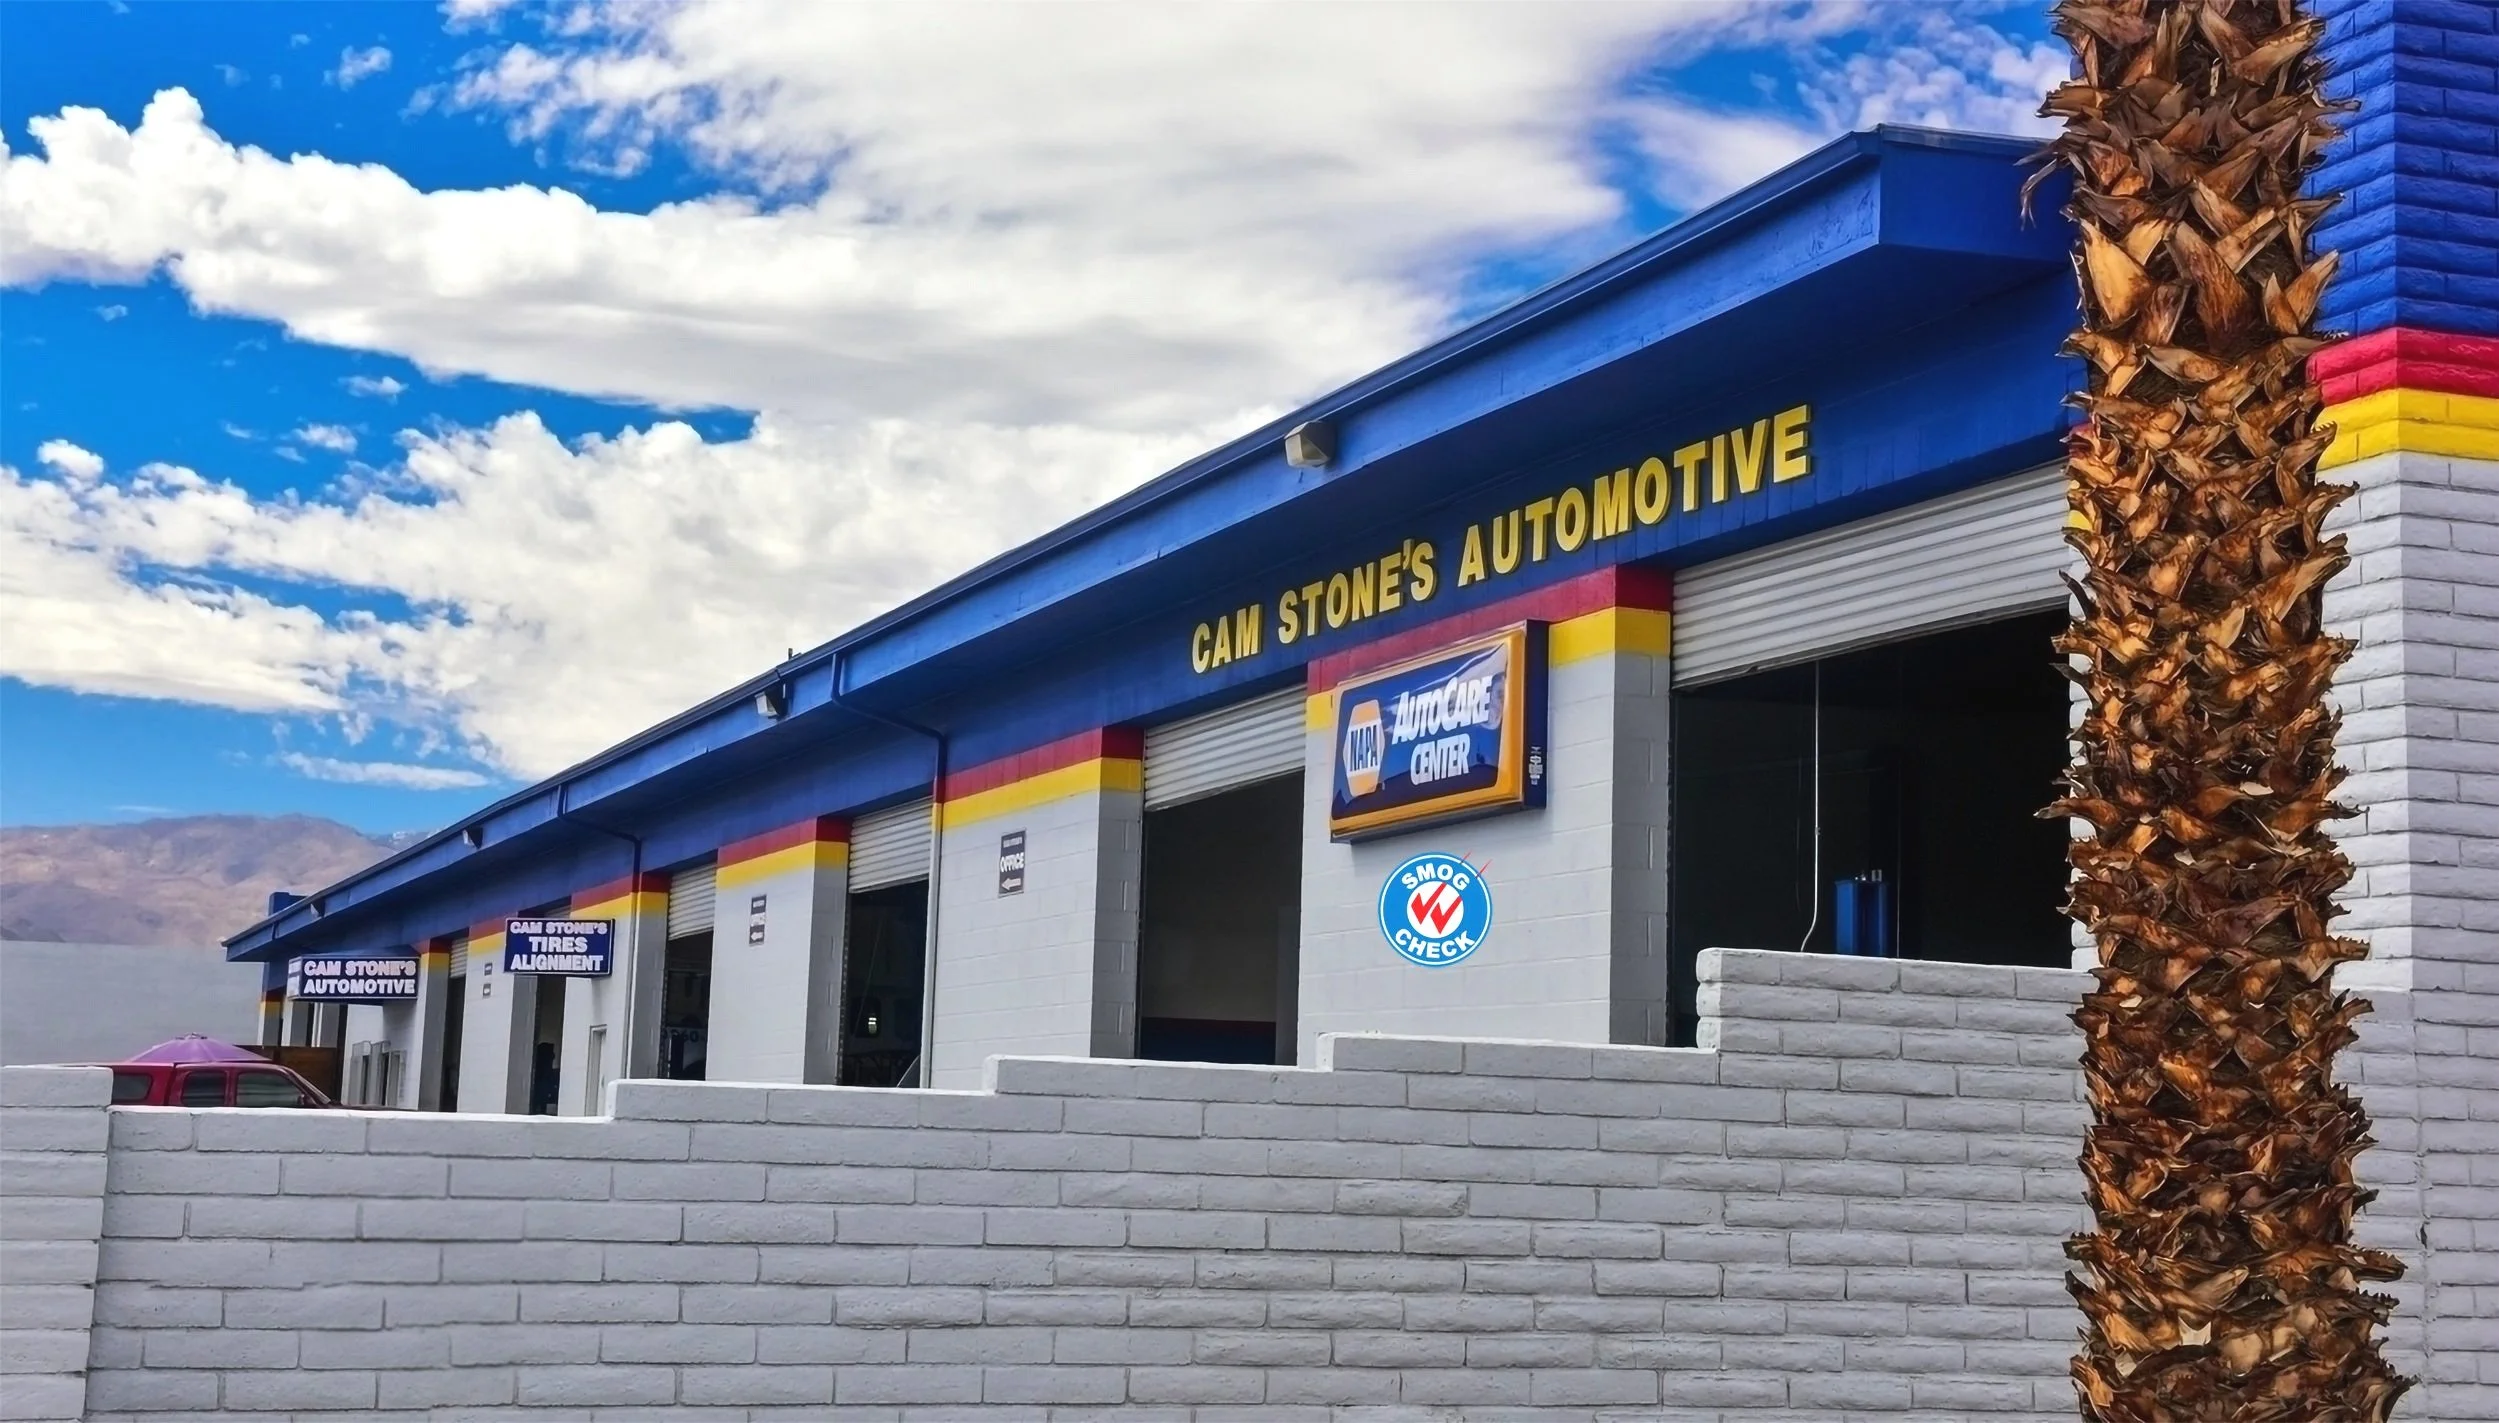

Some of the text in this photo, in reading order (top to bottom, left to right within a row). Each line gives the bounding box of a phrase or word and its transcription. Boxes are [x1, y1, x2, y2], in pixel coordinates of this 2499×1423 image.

[1191, 404, 1811, 674] CAM STONE'S AUTOMOTIVE
[1349, 725, 1379, 772] NAPA
[1410, 733, 1471, 785] CENTER
[1401, 862, 1470, 891] SMOG
[510, 921, 608, 935] CAM STONE'S
[528, 936, 589, 954] TIRES
[1395, 928, 1475, 959] CHECK
[303, 960, 417, 977] CAM STONE'S
[510, 954, 604, 972] ALIGNMENT
[303, 978, 416, 995] AUTOMOTIVE
